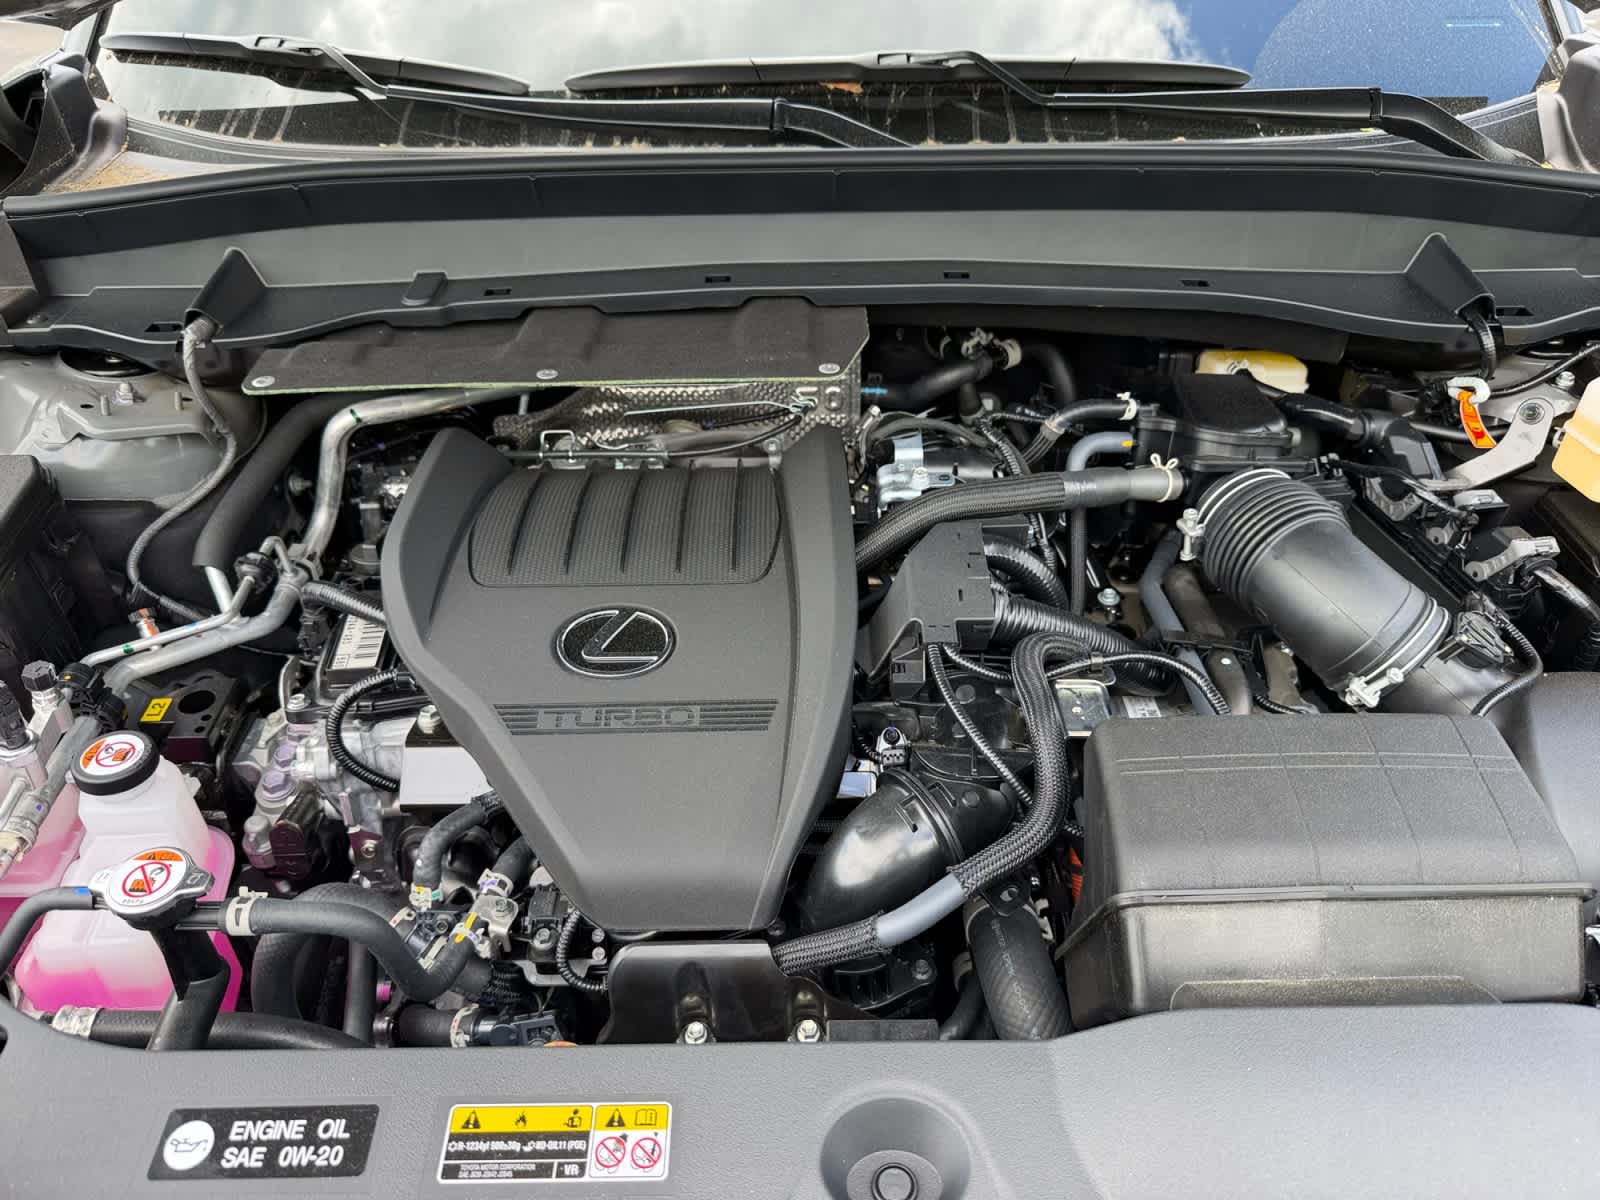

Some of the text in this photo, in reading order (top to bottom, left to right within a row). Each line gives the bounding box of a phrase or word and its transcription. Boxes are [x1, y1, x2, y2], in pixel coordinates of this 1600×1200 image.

[538, 706, 698, 729] TURBO
[229, 1118, 350, 1141] ENGINE OIL
[220, 1145, 344, 1168] SAE 0W-20
[563, 1164, 580, 1177] VR
